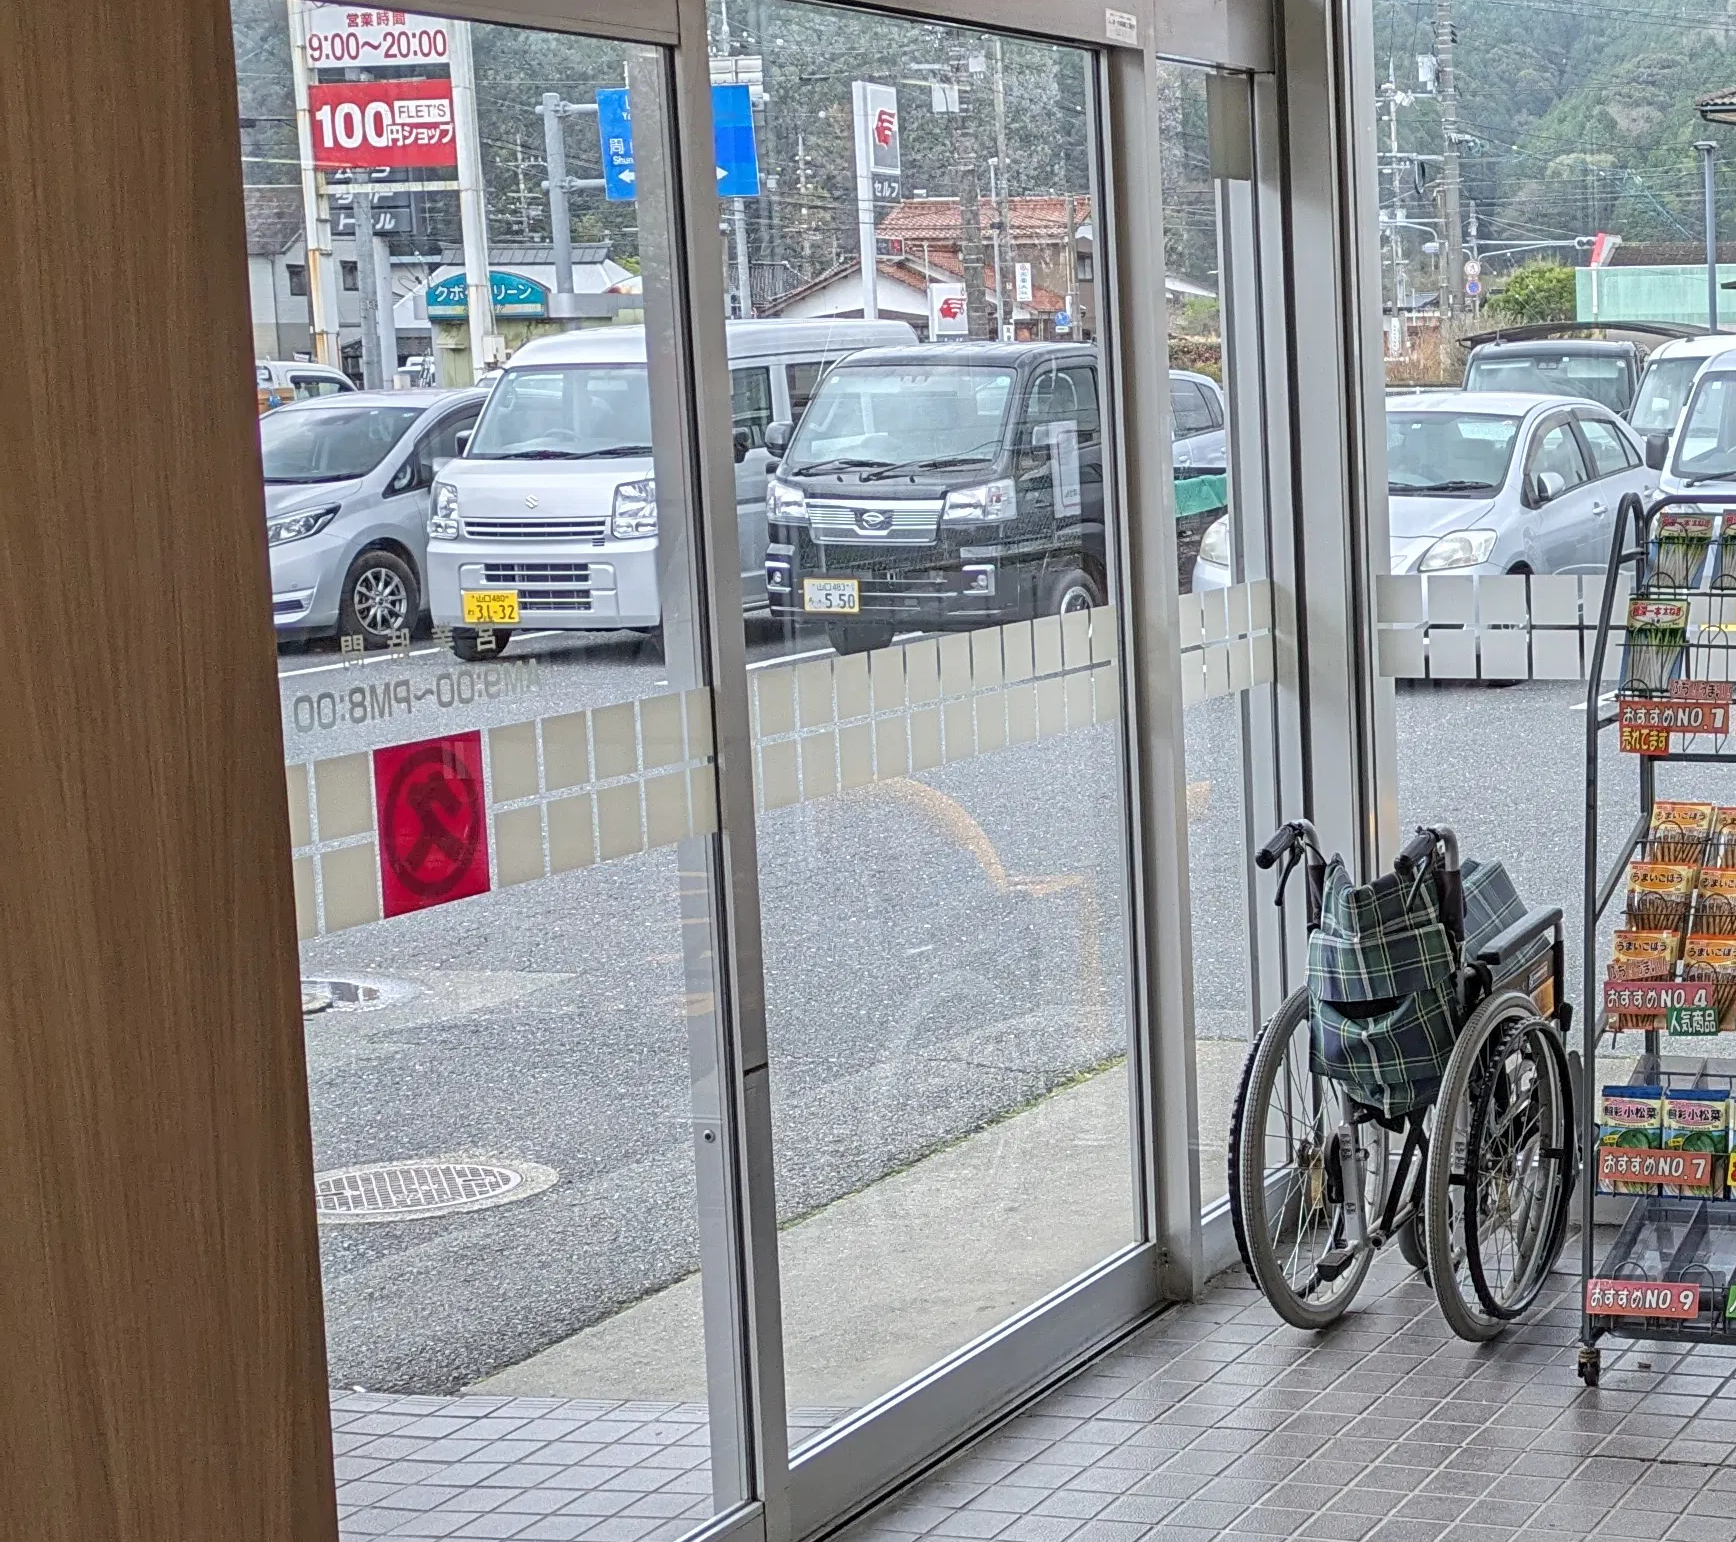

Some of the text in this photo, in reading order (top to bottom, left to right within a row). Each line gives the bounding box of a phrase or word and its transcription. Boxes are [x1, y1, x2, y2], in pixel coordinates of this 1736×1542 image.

[346, 11, 406, 27] 営業時間
[398, 103, 446, 118] FLET'S
[874, 181, 898, 197] セルフ
[1621, 729, 1668, 751] 売れてます
[1670, 1010, 1716, 1034] 人気商品
